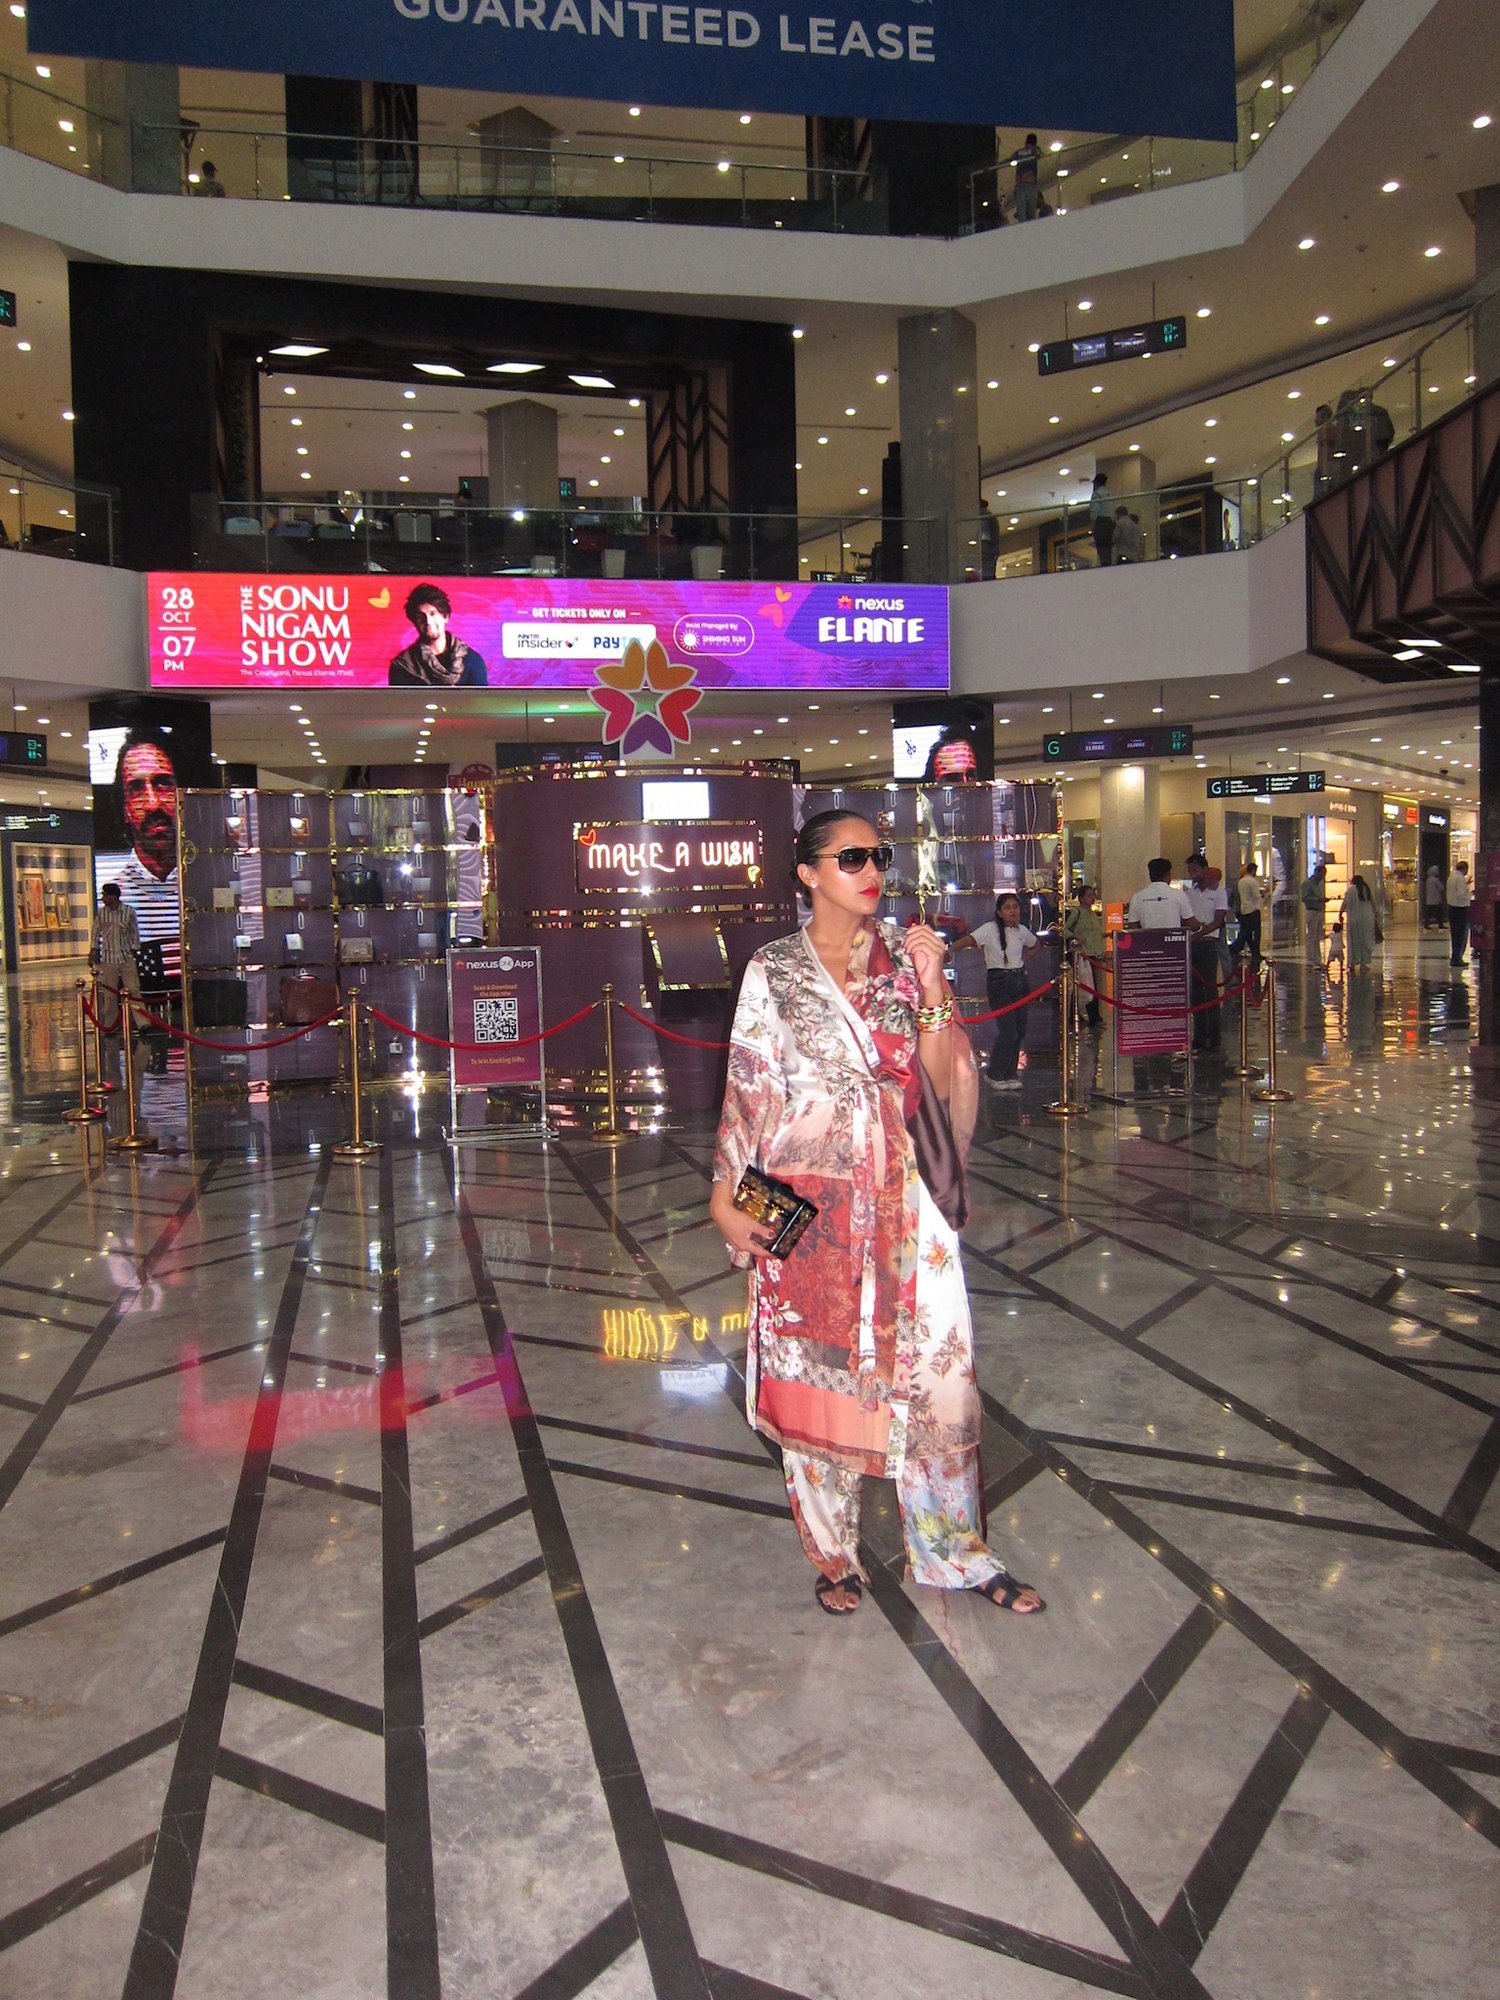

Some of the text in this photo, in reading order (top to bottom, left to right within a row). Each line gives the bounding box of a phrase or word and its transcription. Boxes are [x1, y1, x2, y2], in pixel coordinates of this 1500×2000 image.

[778, 14, 936, 63] LEASE
[1043, 352, 1050, 367] 1
[161, 587, 195, 610] 28
[240, 585, 254, 612] THE
[257, 584, 349, 612] SONU
[854, 597, 905, 611] nexus
[162, 611, 191, 624] OCT
[532, 608, 626, 619] GET TICKETS ONLY ON
[241, 613, 351, 639] NIGAM
[818, 616, 925, 644] ELANTE
[162, 636, 196, 657] 07
[517, 637, 563, 649] insider
[241, 640, 352, 667] SHOW
[163, 659, 185, 671] PM
[1047, 740, 1061, 756] G
[1211, 781, 1222, 795] G
[588, 840, 755, 876] MAKE A WISH
[466, 960, 499, 970] nexus
[514, 959, 534, 969] App
